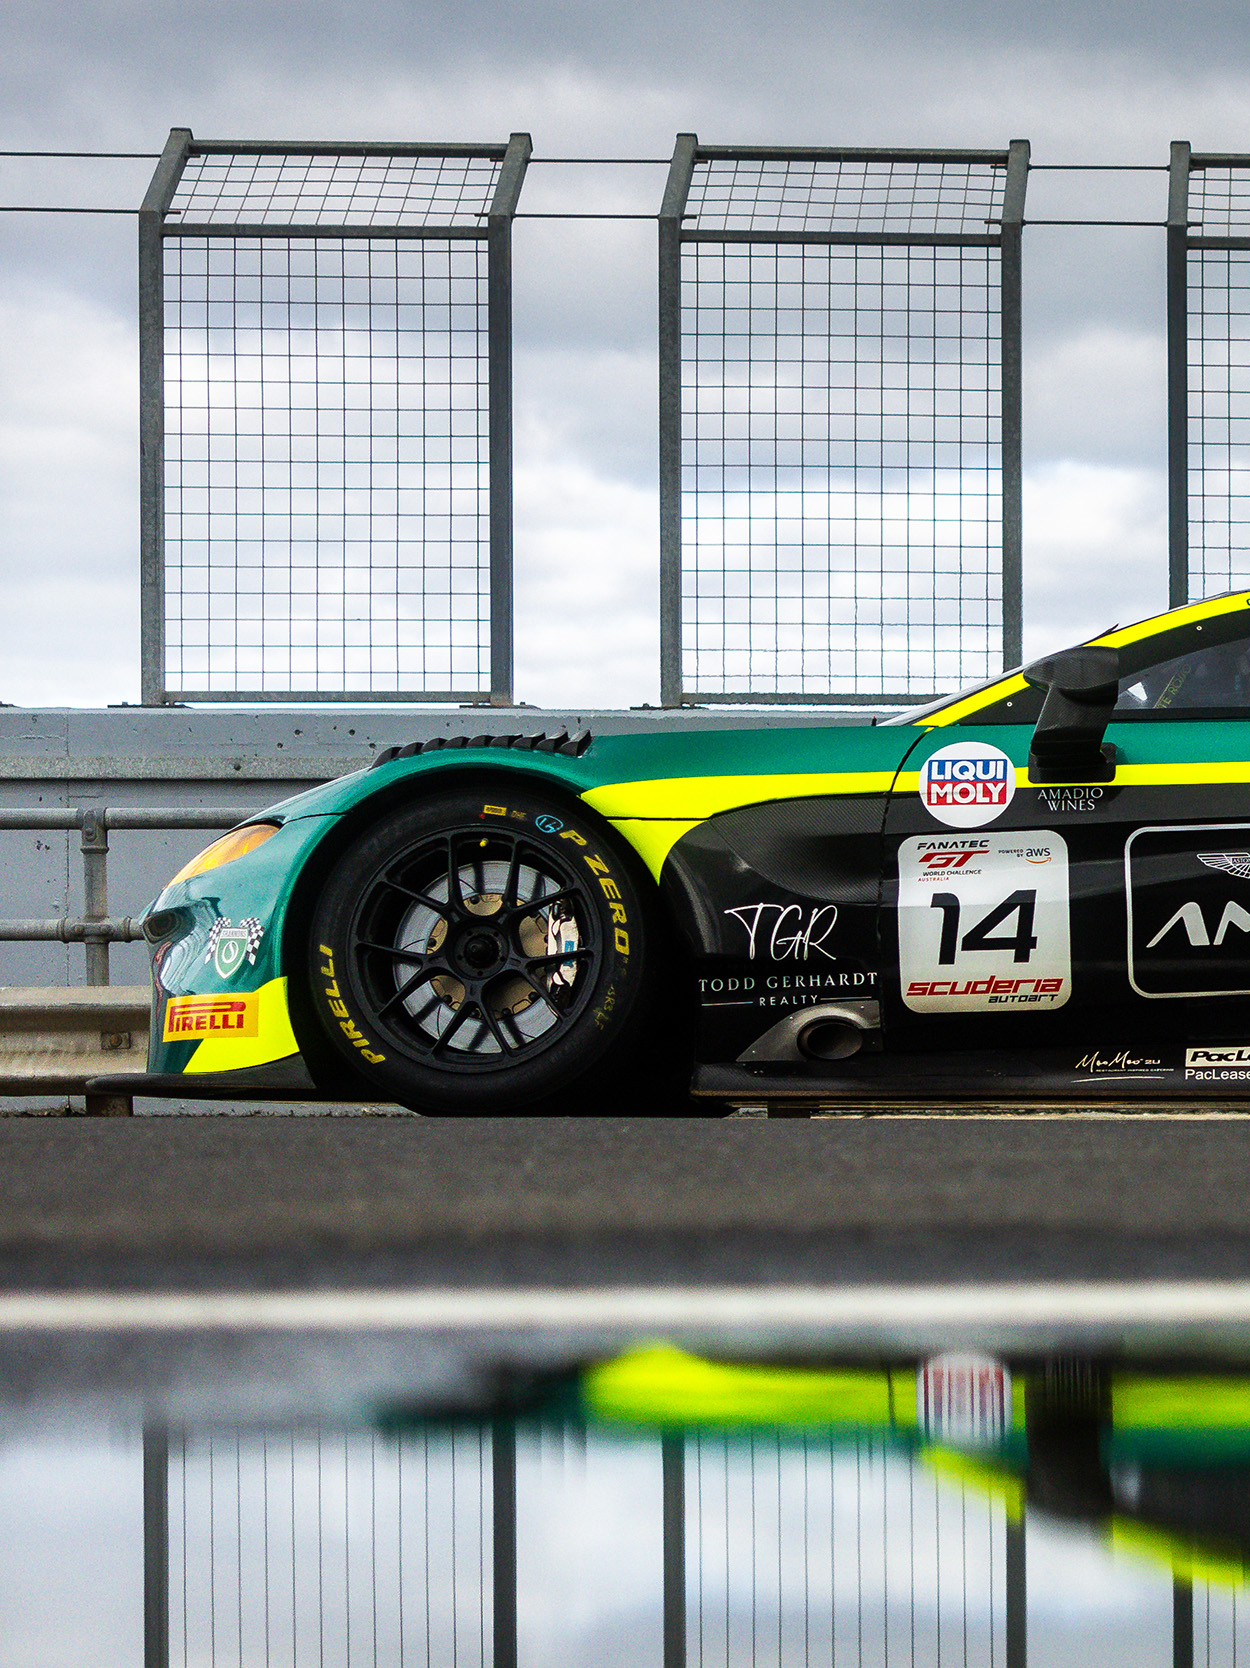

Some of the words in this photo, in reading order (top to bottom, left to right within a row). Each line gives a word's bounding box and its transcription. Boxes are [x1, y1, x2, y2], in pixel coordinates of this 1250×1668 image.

[931, 760, 1004, 781] LIQUI
[930, 782, 1006, 804] MOLY
[1037, 787, 1104, 801] AMADIO
[1047, 799, 1096, 811] WINES
[916, 840, 990, 850] FANATEC
[1025, 848, 1051, 858] aws
[723, 902, 838, 961] TGR
[930, 889, 1039, 966] 14
[698, 977, 755, 992] TODD
[766, 972, 878, 989] GERHARDT
[906, 975, 1064, 997] scuderia
[319, 944, 386, 1065] PIRELLI
[759, 994, 818, 1007] REALTY
[168, 1001, 247, 1033] PIRELLI
